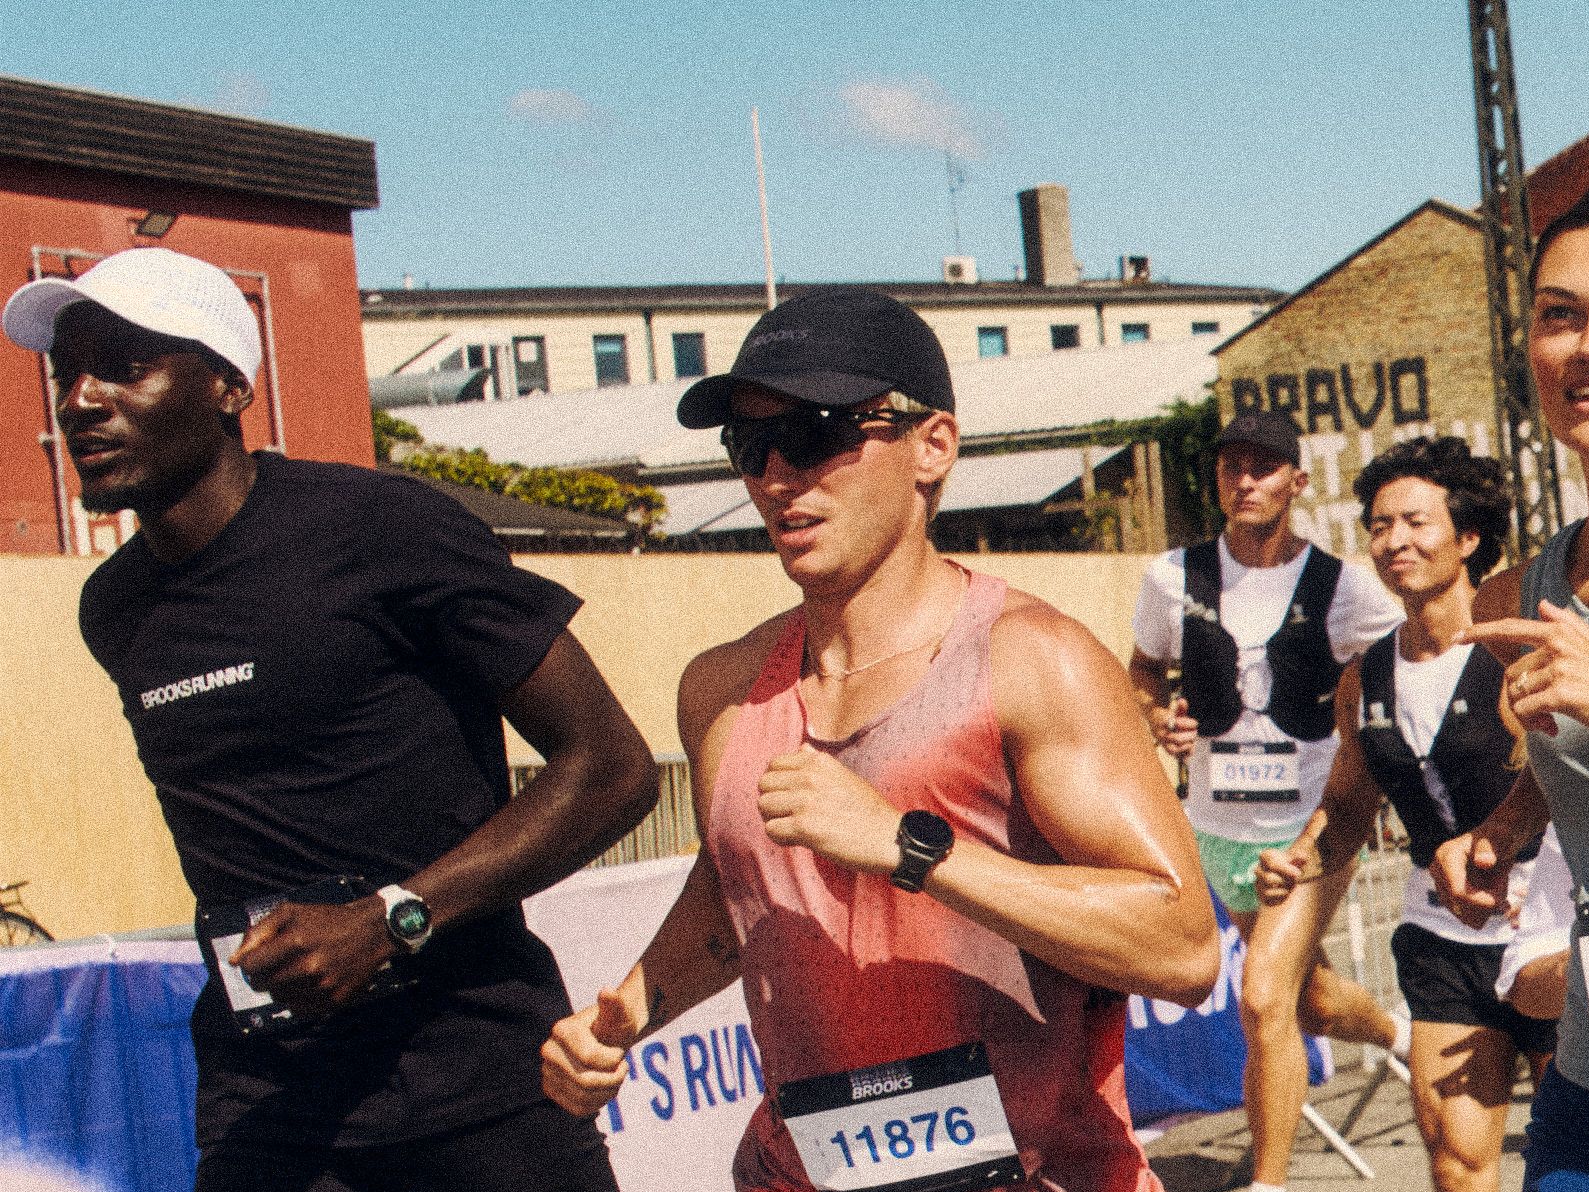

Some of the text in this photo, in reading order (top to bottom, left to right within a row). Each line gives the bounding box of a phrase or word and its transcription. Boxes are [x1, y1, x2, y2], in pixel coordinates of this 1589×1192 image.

[1231, 356, 1430, 433] BRAVO
[851, 1075, 913, 1100] BROOKS
[830, 1105, 976, 1169] 11876
